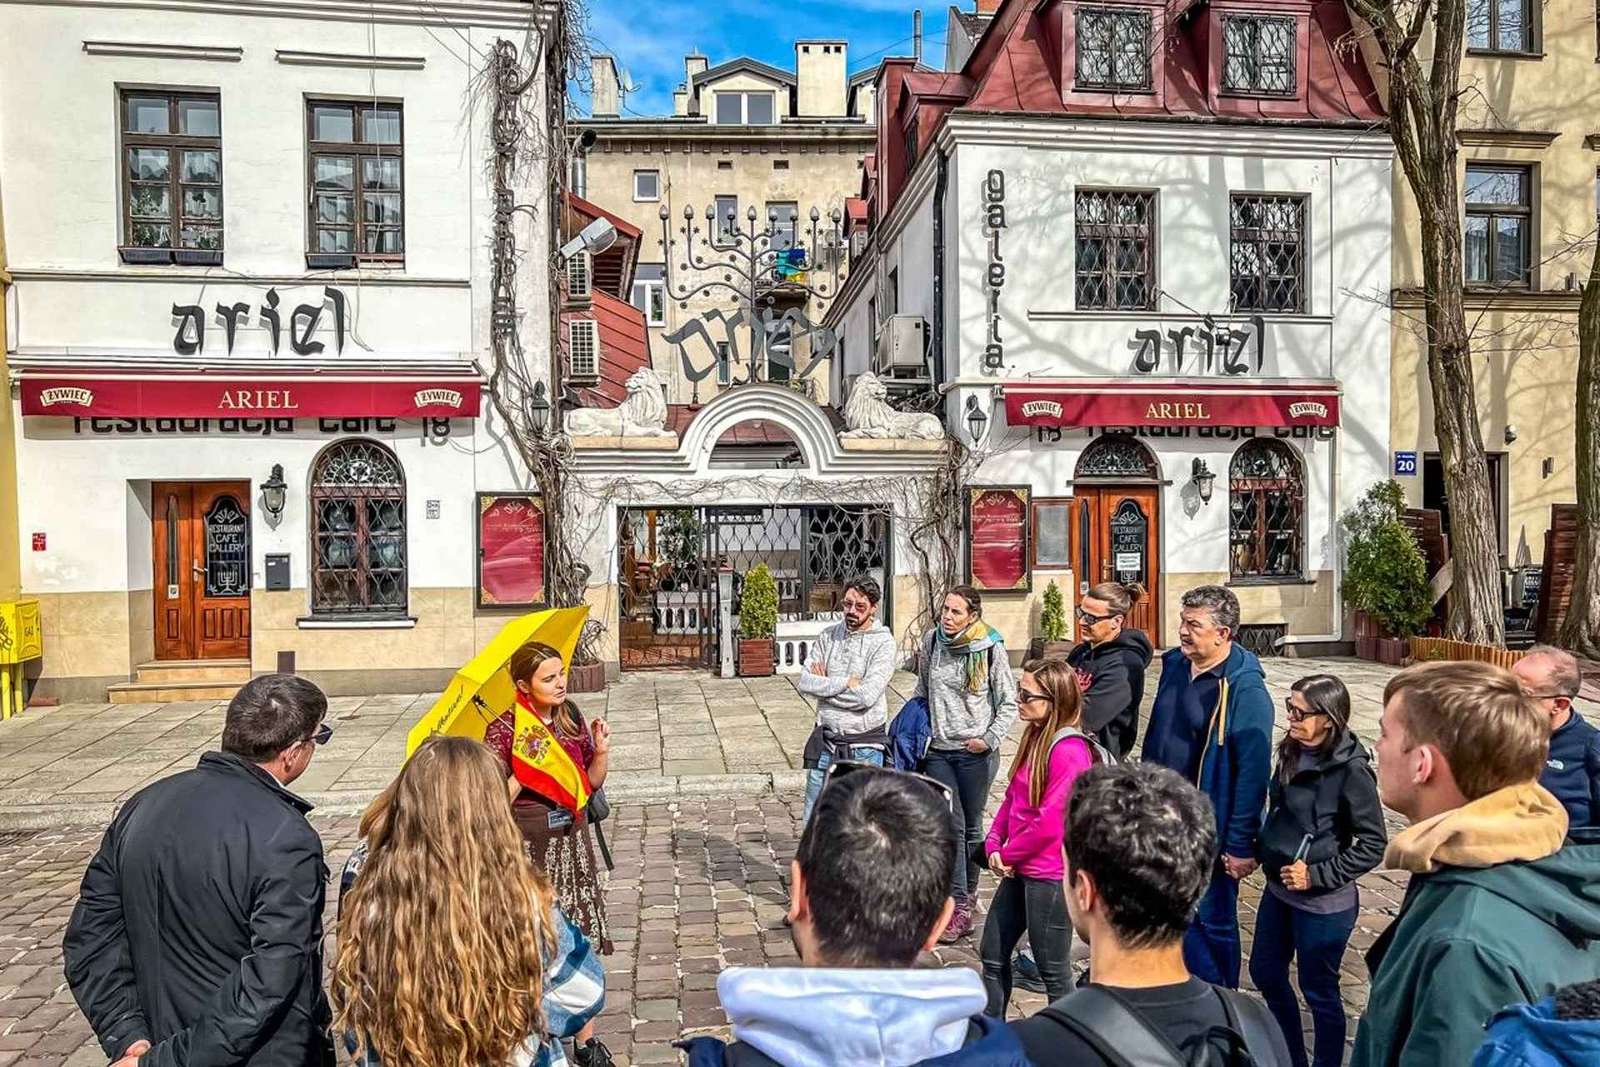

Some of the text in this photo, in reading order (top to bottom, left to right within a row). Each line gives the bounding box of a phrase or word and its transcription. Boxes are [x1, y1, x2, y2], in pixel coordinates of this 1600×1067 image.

[986, 169, 1008, 368] galeria
[171, 286, 345, 357] ariel
[219, 391, 299, 409] ARIEL
[1145, 402, 1210, 420] ARIEL
[1397, 460, 1415, 472] 20
[215, 534, 238, 543] CAFE
[1119, 535, 1138, 543] CAFE
